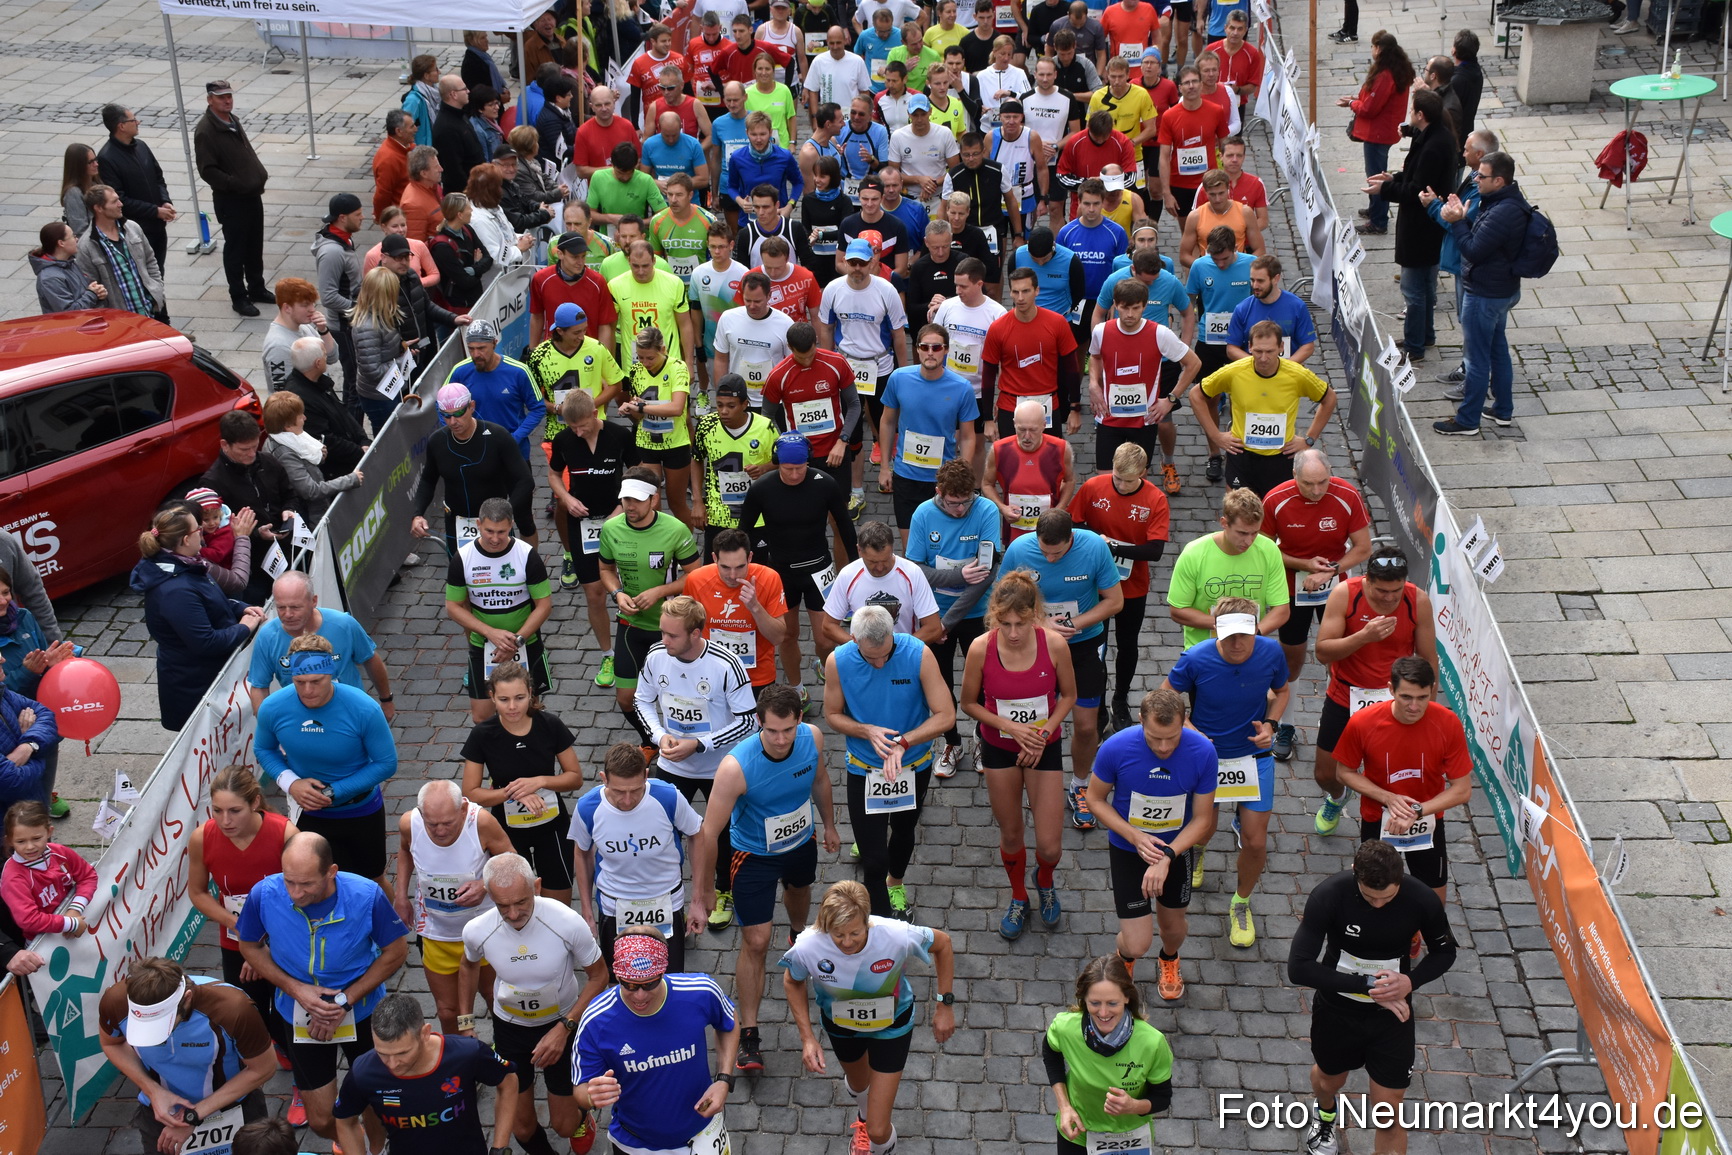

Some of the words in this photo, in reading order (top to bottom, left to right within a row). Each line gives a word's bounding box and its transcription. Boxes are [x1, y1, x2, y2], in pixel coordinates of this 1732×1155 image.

[231, 1, 251, 9] um
[253, 0, 273, 10] frei
[275, 3, 289, 11] zu
[292, 2, 320, 12] sein.
[1122, 50, 1140, 59] 2540
[1181, 155, 1203, 165] 2469
[662, 239, 703, 250] BOCK
[673, 265, 694, 276] 2721
[631, 301, 658, 309] Müller
[954, 351, 971, 364] 146
[749, 371, 762, 380] 60
[384, 376, 398, 394] swn
[1114, 393, 1141, 405] 2092
[799, 409, 828, 423] 2584
[1250, 424, 1280, 436] 2940
[916, 444, 930, 455] 97
[1020, 506, 1041, 517] 128
[20, 514, 38, 525] BMW
[340, 490, 387, 582] BOCK
[269, 557, 279, 574] swn
[1482, 553, 1500, 575] swn
[472, 589, 523, 597] Laufteam
[710, 616, 747, 625] funrunners
[61, 699, 105, 713] RÖDL
[668, 706, 703, 722] 2545
[1010, 709, 1037, 724] 284
[793, 765, 813, 778] THULE
[1219, 771, 1246, 785] 299
[872, 780, 909, 796] 2648
[1142, 807, 1173, 819] 227
[774, 815, 807, 841] 2655
[624, 908, 665, 925] 2446
[1584, 940, 1594, 957] die
[1588, 921, 1611, 974] Neumarkts
[517, 999, 540, 1010] 16
[847, 1008, 877, 1020] 181
[623, 1043, 696, 1073] Hofmühl
[381, 1099, 466, 1130] MENSCH
[186, 1125, 235, 1150] 2707
[1096, 1138, 1142, 1151] 2232
